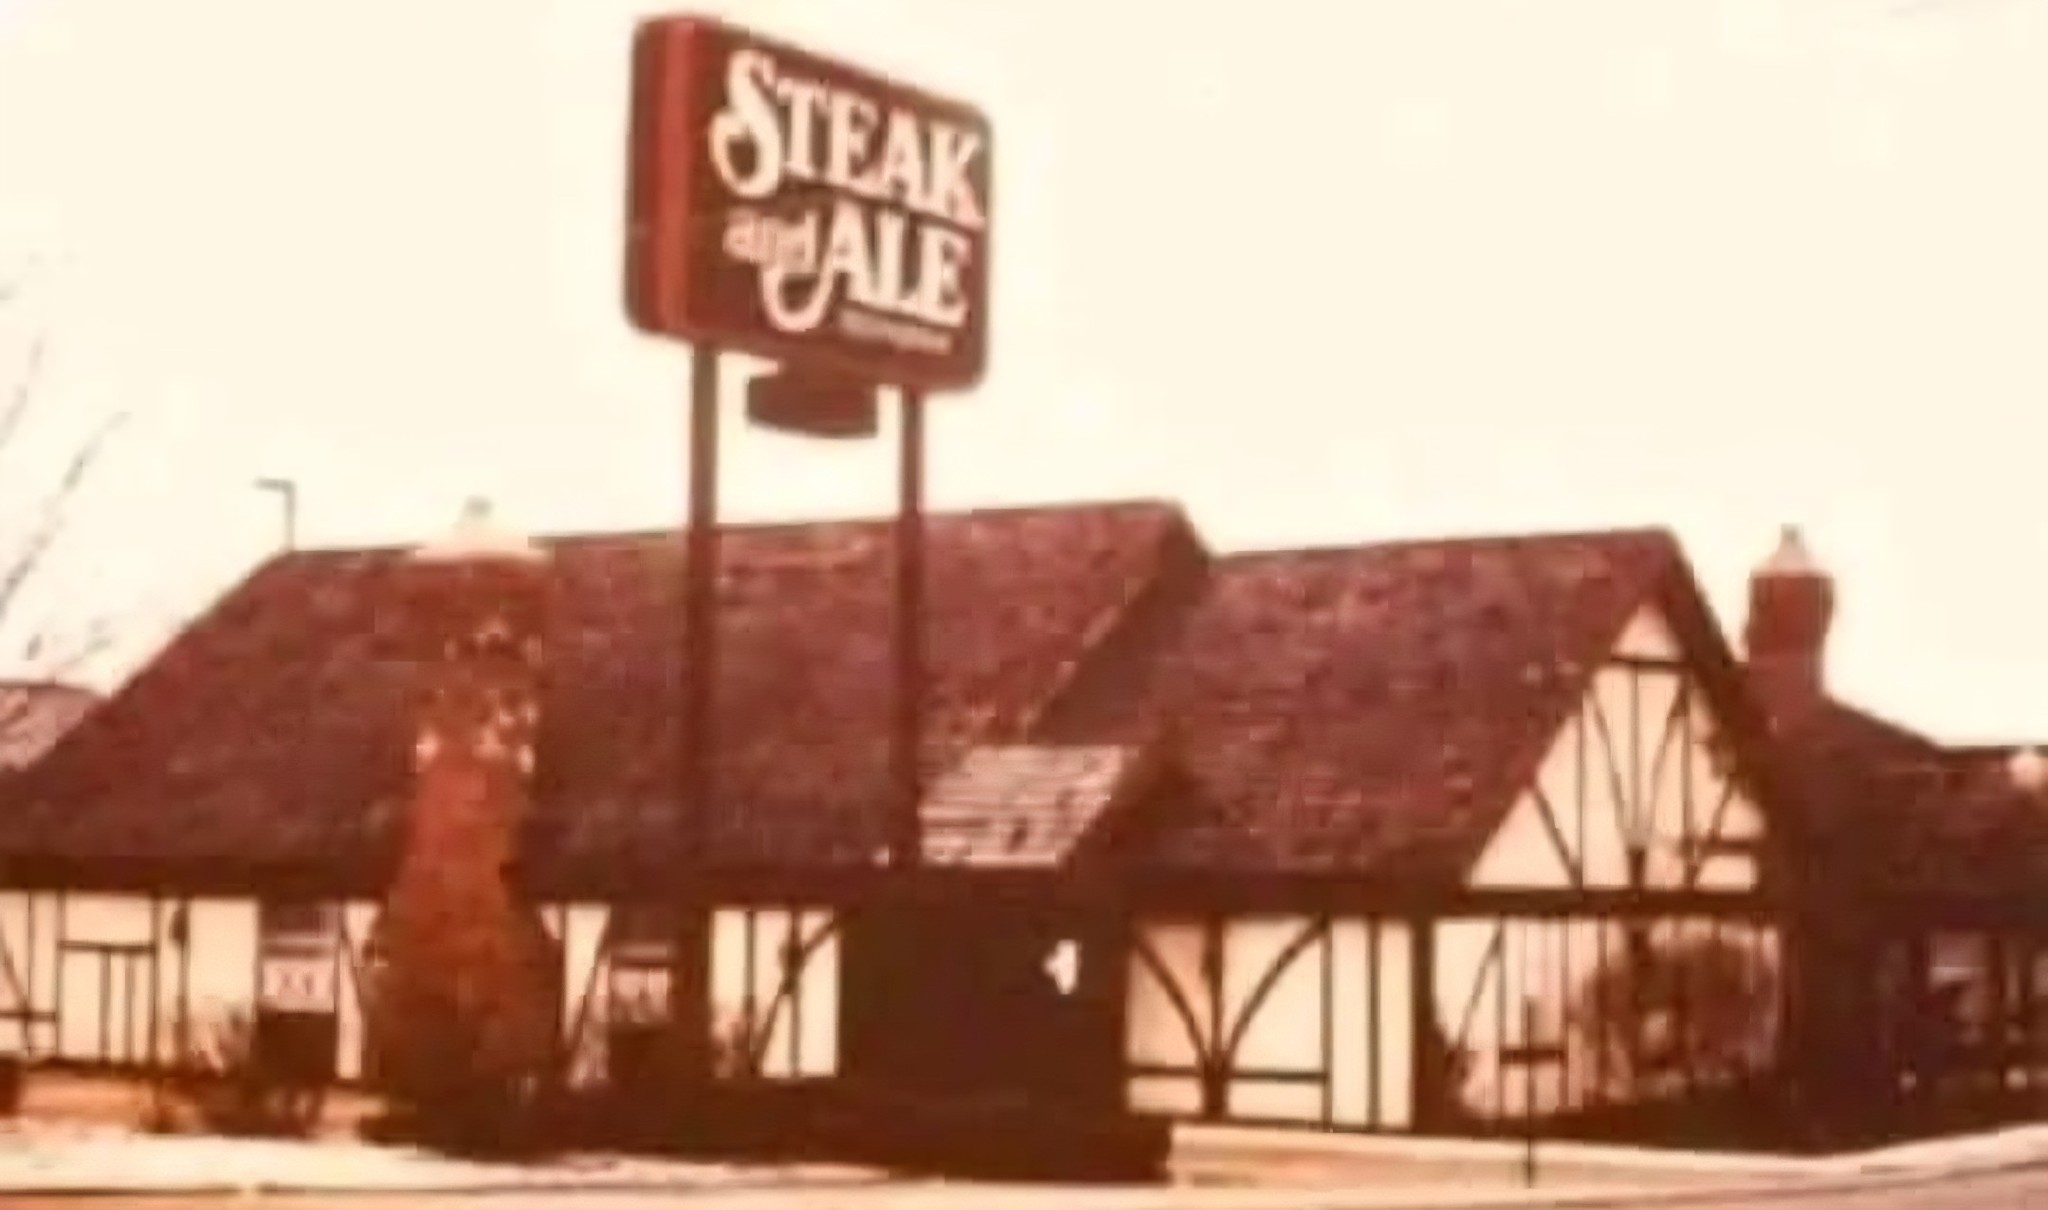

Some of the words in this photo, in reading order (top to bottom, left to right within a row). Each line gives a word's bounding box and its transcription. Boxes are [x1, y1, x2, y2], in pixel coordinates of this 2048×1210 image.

[708, 49, 986, 232] STEAK
[722, 206, 817, 270] and
[764, 200, 972, 332] ALE
